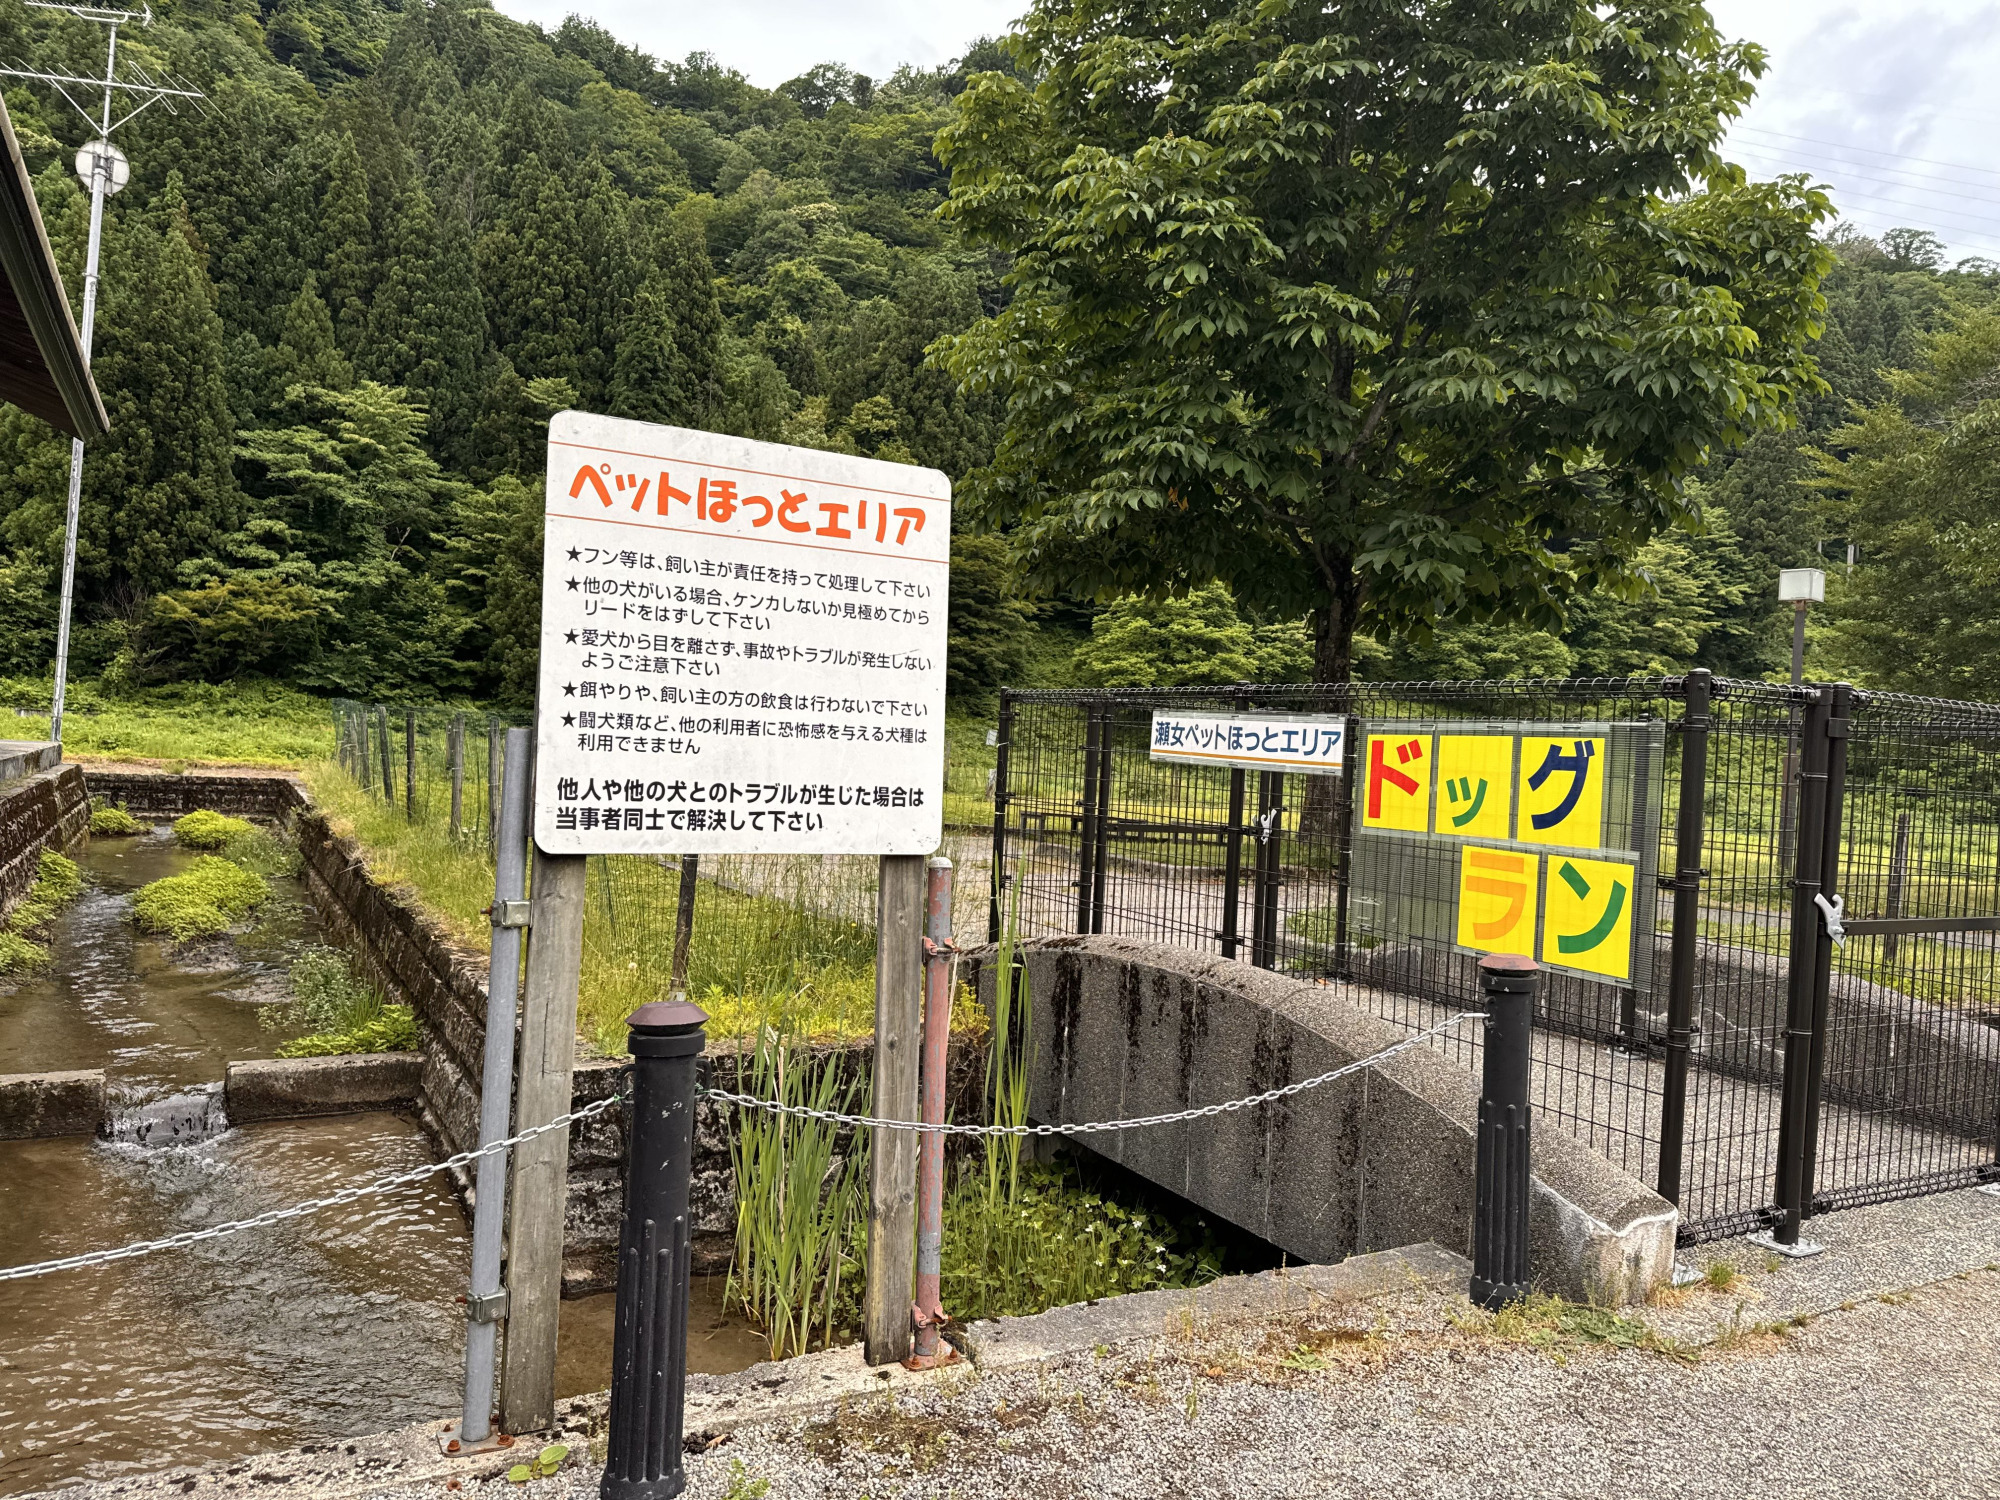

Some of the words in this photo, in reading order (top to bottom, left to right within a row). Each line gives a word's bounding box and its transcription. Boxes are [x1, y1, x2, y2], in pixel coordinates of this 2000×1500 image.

[568, 463, 926, 545] ペットほっとエリア
[584, 548, 931, 598] フン等は、飼い主が責任を持って処理して下さい
[583, 576, 930, 625] 他の犬がいる場合、ケンカしないか見極めてから
[585, 599, 770, 631] リードをはずして下さい
[581, 629, 932, 671] 愛犬から目を離さず、事故やトラブルが発生しない
[582, 651, 720, 676] ようご注意下さい
[580, 681, 928, 717] 餌やりや、飼い主の方の飲食は行わないで下さい
[578, 733, 701, 755] 利用できません
[579, 711, 927, 743] 闘犬類など、他の利用者に恐怖感を与える犬種は
[1154, 721, 1342, 756] 瀬女ペットほっとエリア
[557, 777, 924, 807] 他人や他の犬とのトラブルが生じた場合は
[1368, 739, 1595, 830] ドッグ
[556, 806, 823, 832] 当事者同士で解決して下さい
[1466, 851, 1627, 954] ラン
